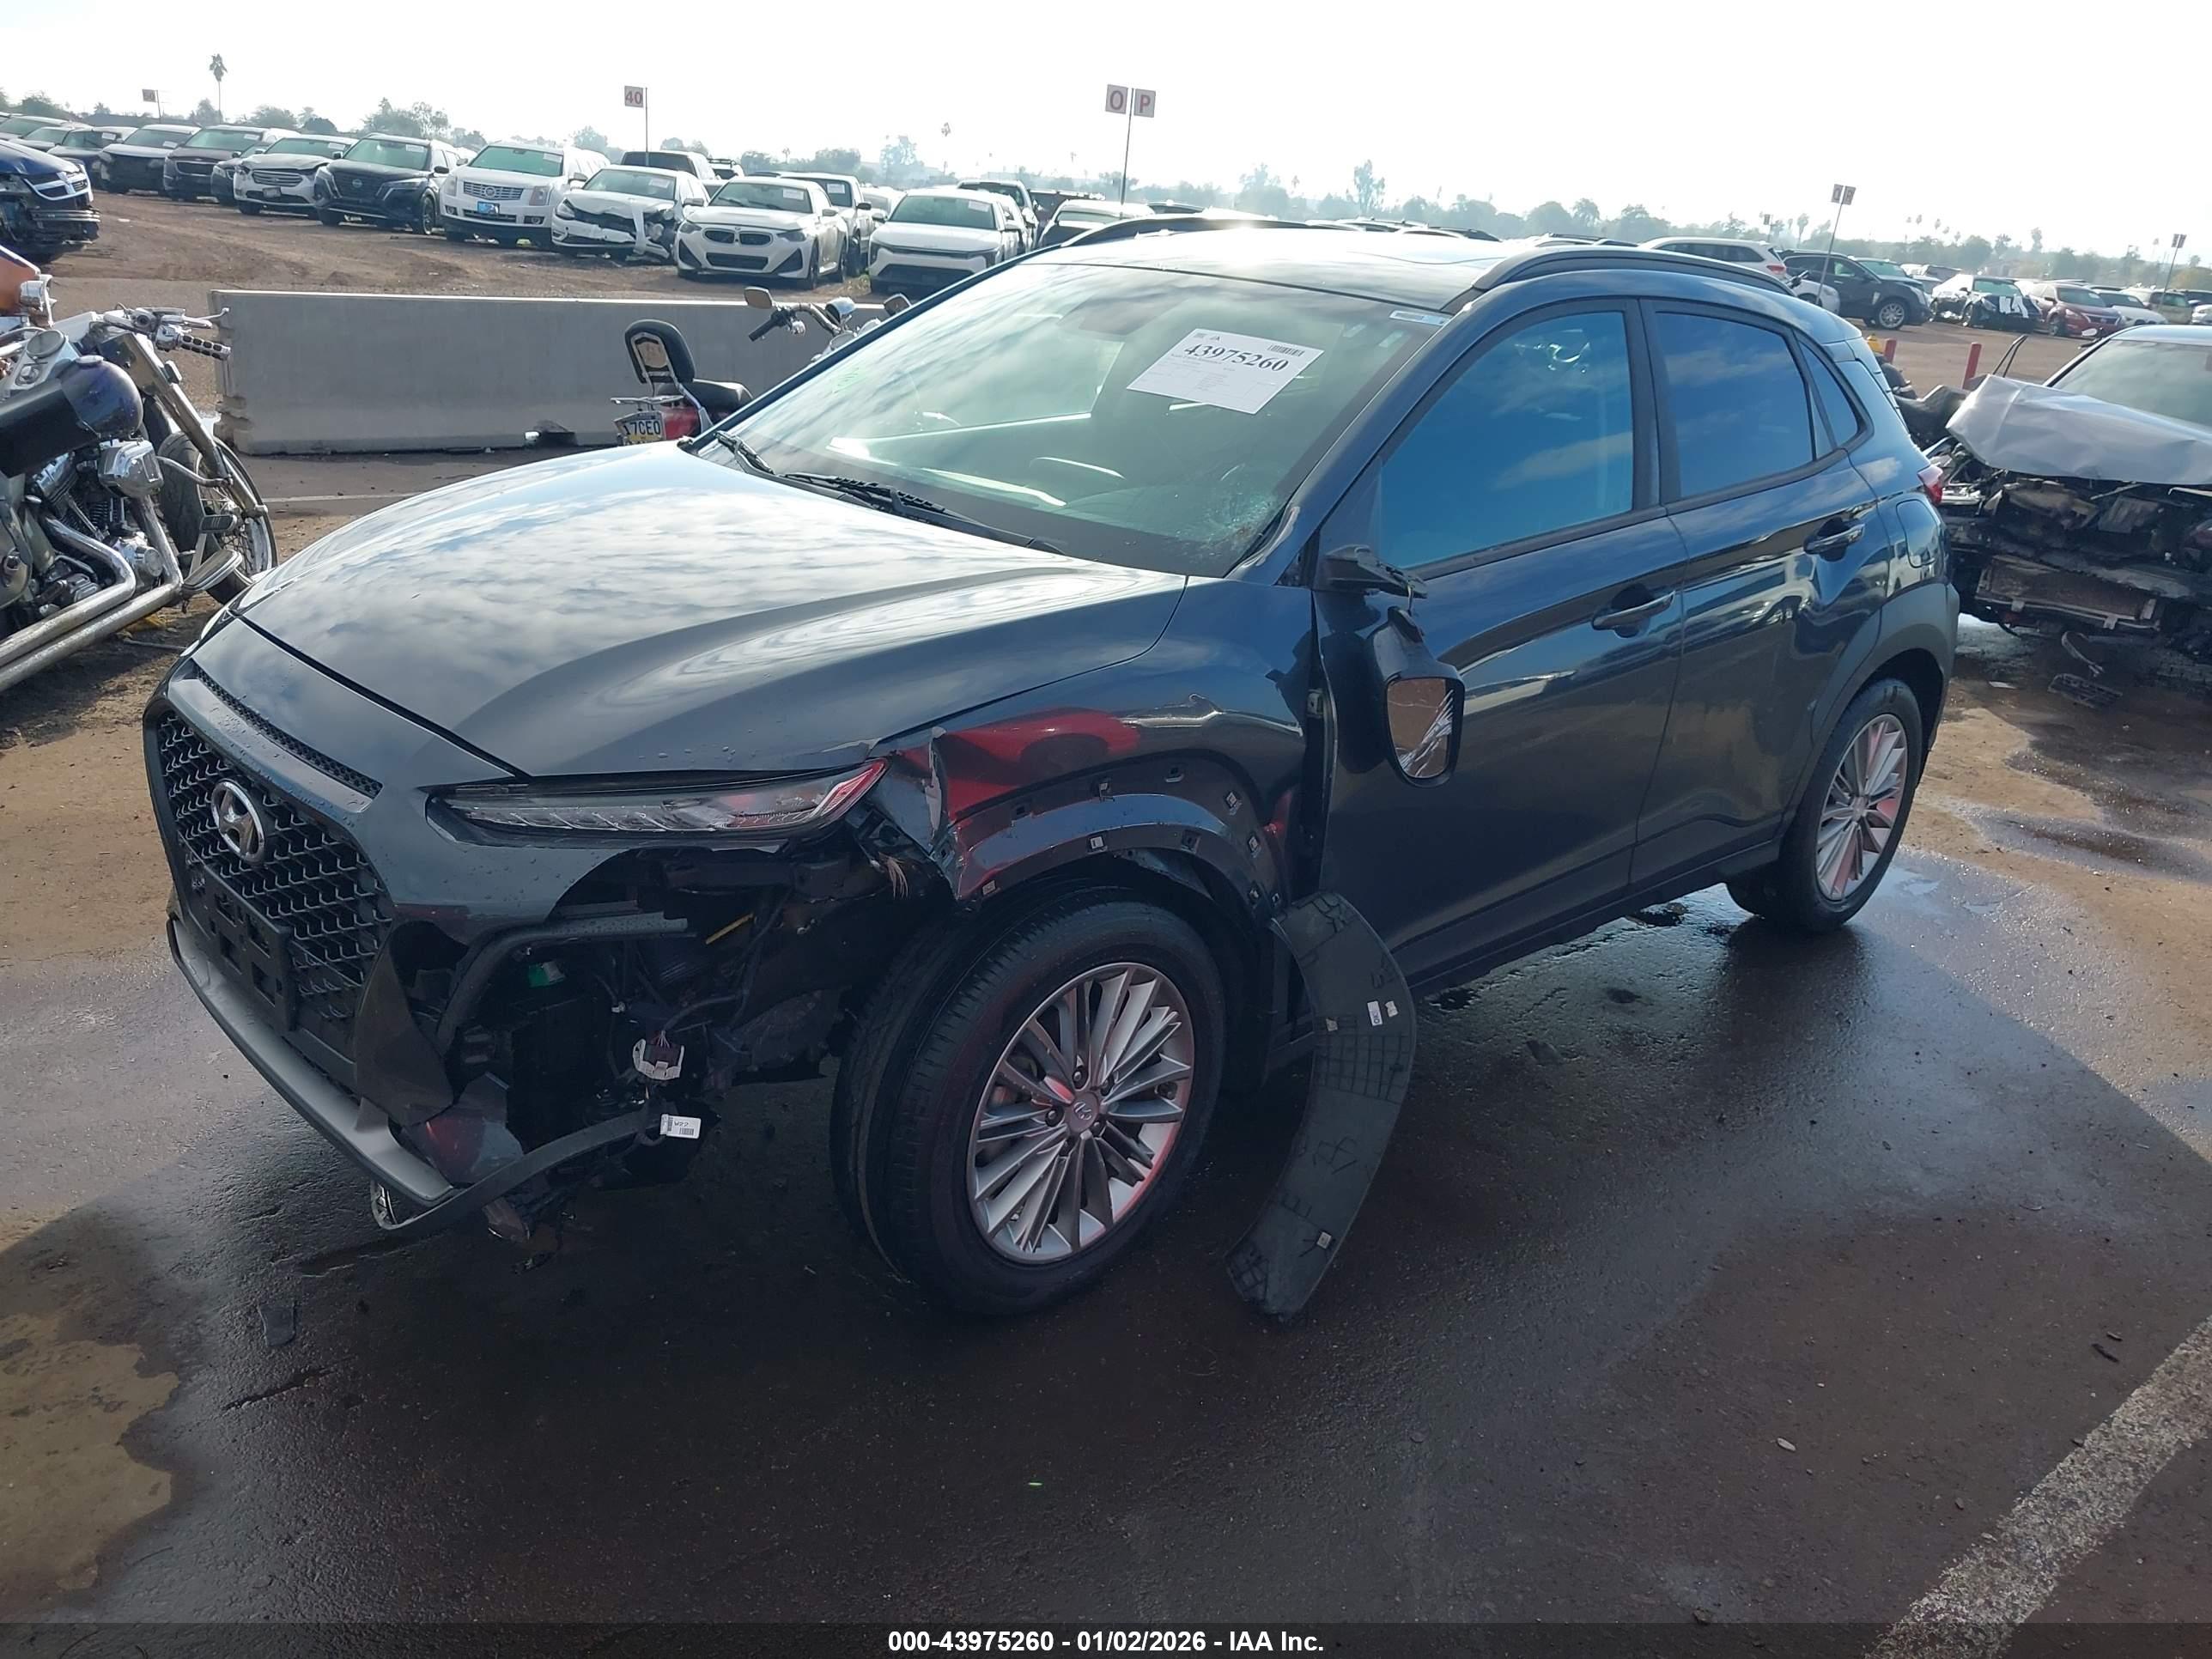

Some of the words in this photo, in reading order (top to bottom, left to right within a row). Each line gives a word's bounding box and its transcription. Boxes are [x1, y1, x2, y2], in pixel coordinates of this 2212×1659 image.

[625, 91, 643, 104] 40
[1139, 94, 1151, 113] P
[1183, 343, 1290, 372] 43975260
